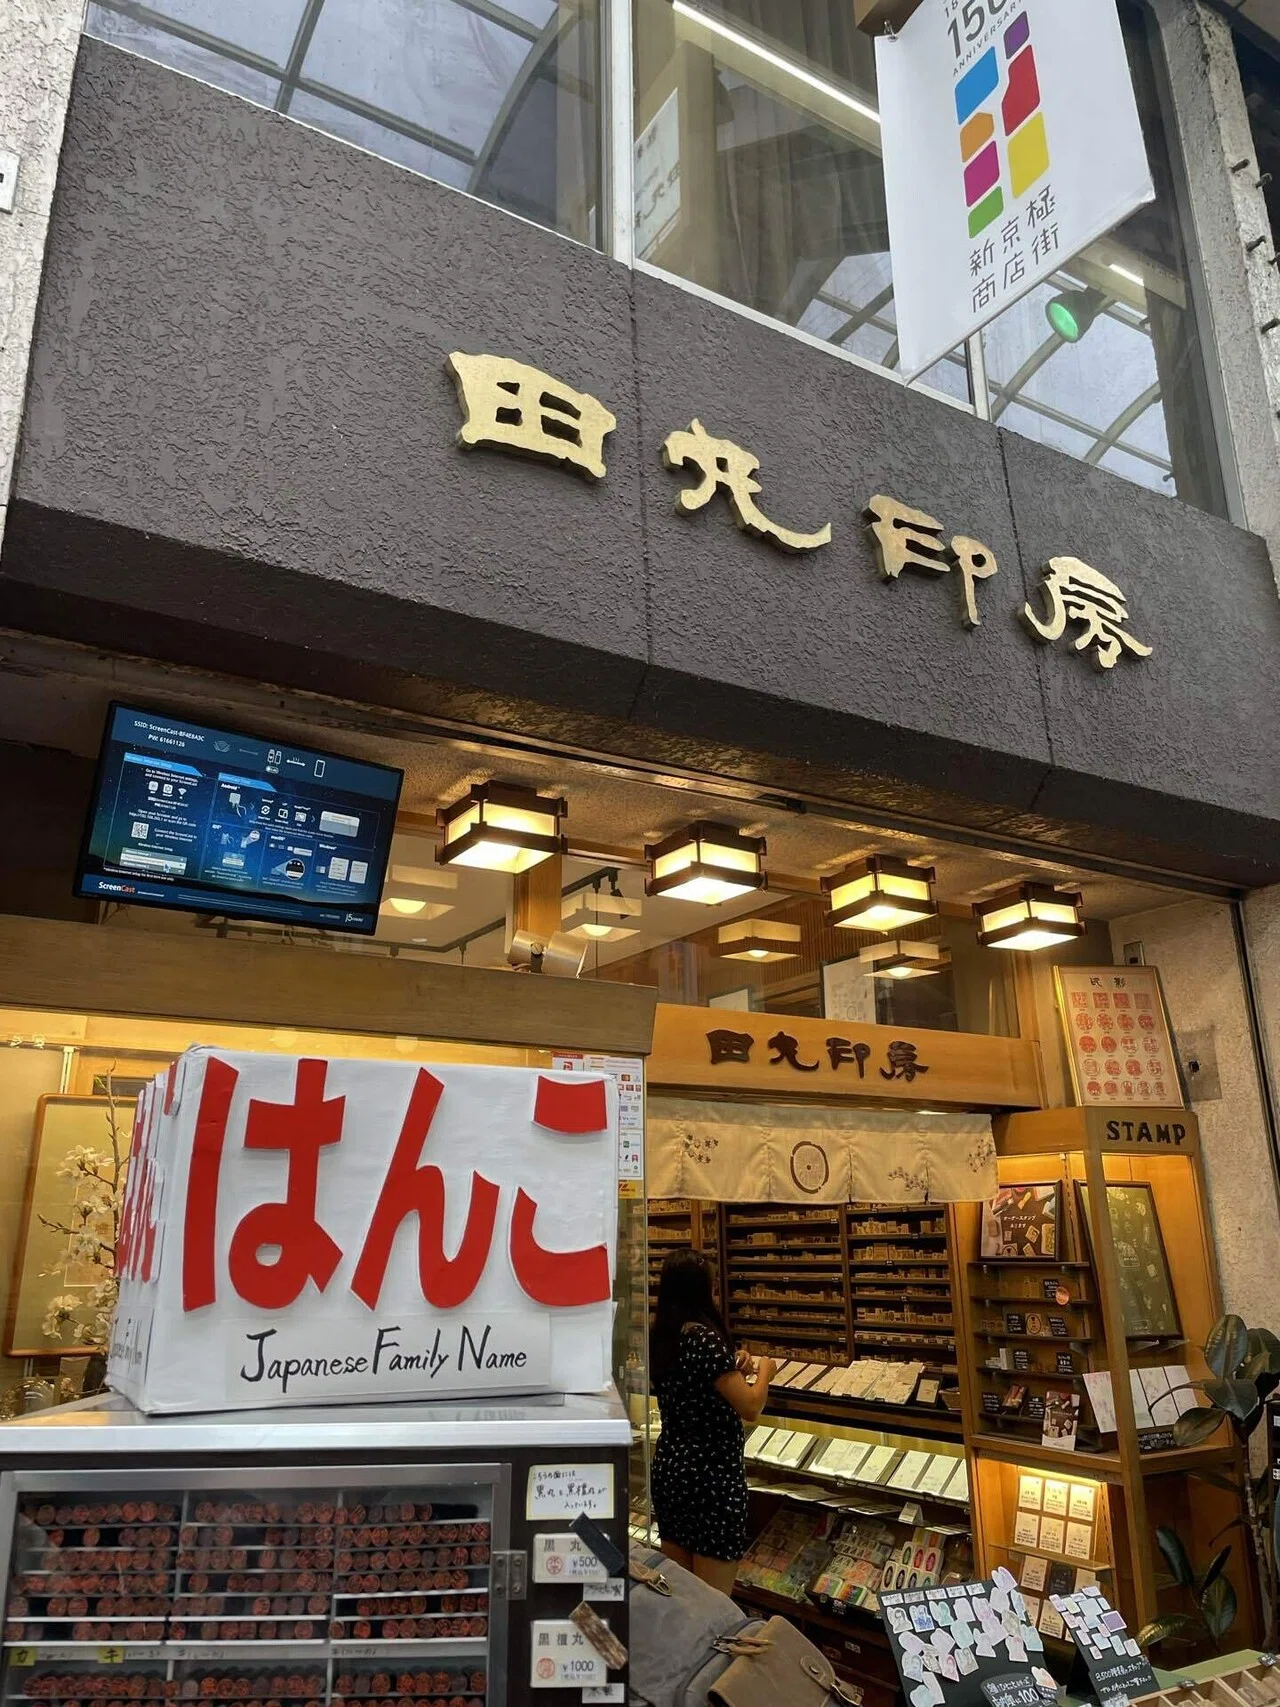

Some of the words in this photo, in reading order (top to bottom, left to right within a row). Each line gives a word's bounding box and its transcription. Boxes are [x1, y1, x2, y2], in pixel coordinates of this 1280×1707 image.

[953, 0, 1023, 76] ANNIVERSAR
[969, 184, 1056, 278] 新京極
[973, 222, 1059, 313] 商店街
[445, 351, 1153, 672] 田丸印房
[98, 881, 136, 893] ScreenCast
[705, 1028, 929, 1082] 田丸印房
[1106, 1120, 1186, 1146] STAMP
[182, 1055, 612, 1313] はんこ
[240, 1328, 370, 1393] Japanese
[373, 1326, 450, 1379] Family
[457, 1325, 528, 1371] Name
[573, 1556, 598, 1568] ¥500
